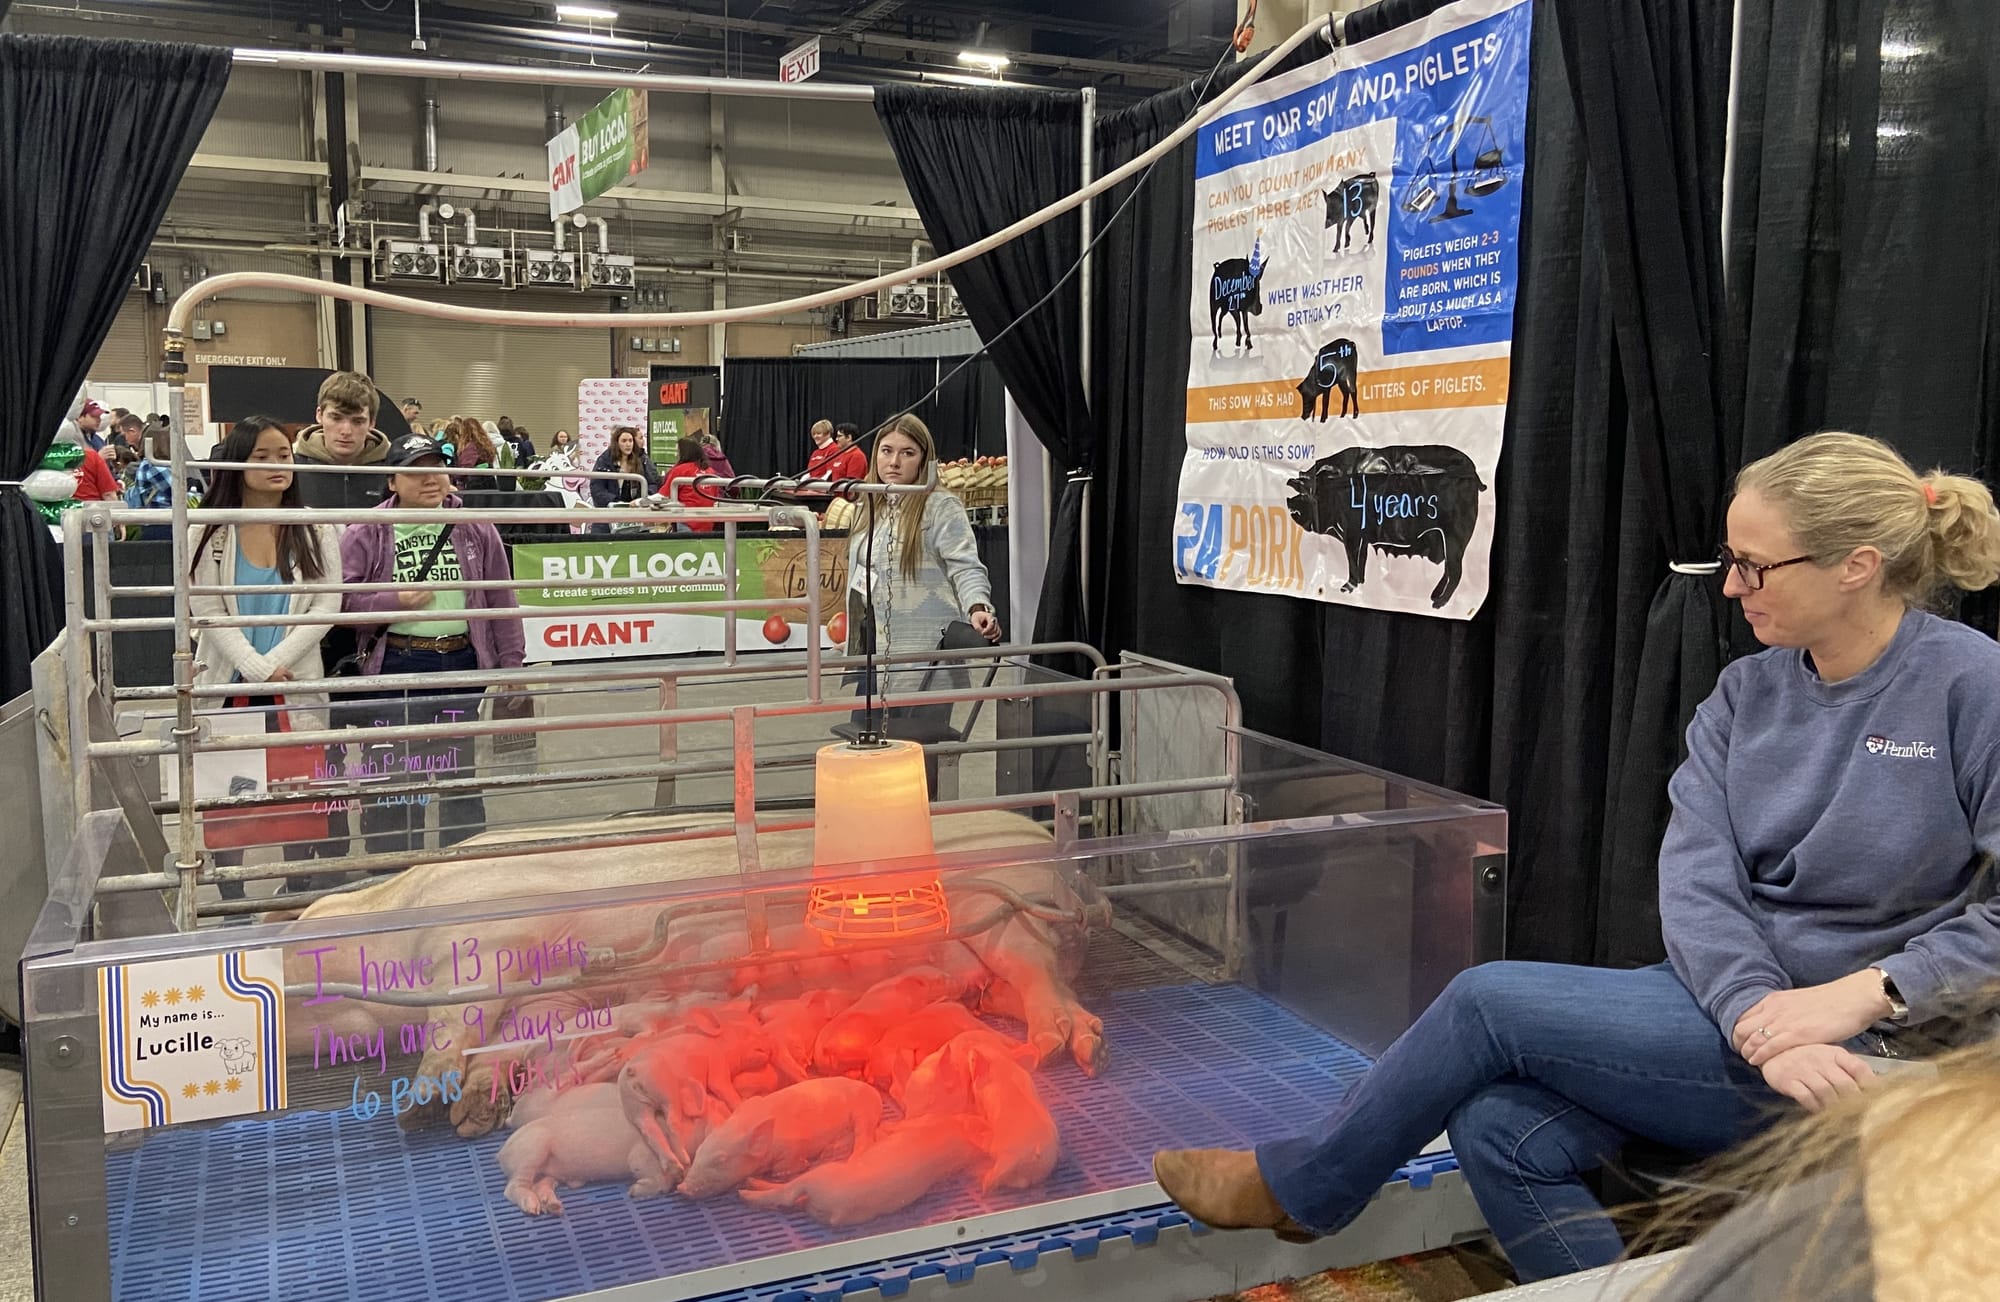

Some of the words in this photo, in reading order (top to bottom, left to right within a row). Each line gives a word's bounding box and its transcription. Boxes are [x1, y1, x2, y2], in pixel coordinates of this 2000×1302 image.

[787, 49, 818, 82] EXIT
[1215, 121, 1255, 156] MEET
[1263, 106, 1301, 140] OUR
[1347, 72, 1396, 110] AND
[1405, 32, 1498, 94] PIGLETS
[582, 132, 599, 165] BUY
[1208, 193, 1230, 209] CAN
[1232, 184, 1252, 202] YOU
[1259, 170, 1299, 194] COUNT
[1302, 164, 1324, 185] HOW
[1324, 147, 1366, 174] MANY
[1208, 211, 1248, 235] PIGLETS
[1251, 200, 1291, 222] THERE
[1295, 189, 1319, 212] ARE?
[1342, 181, 1364, 219] 13
[1403, 242, 1441, 262] PIGLETS
[1444, 235, 1479, 254] WEIGH
[1481, 230, 1500, 246] 2-3
[1400, 262, 1439, 281] POUNDS
[1441, 256, 1472, 273] WHEN
[1474, 250, 1501, 267] THEY
[1214, 272, 1257, 301] December
[1302, 281, 1322, 299] WAS
[1323, 275, 1364, 294] THEIR
[1399, 285, 1420, 300] ARE
[1453, 273, 1488, 291] WHICH
[1490, 271, 1501, 285] IS
[1397, 303, 1427, 318] ABOUT
[1429, 301, 1443, 314] AS
[1445, 294, 1476, 312] MUCH
[1477, 292, 1492, 306] AS
[1494, 291, 1502, 304] A
[1426, 316, 1467, 333] LAPTOP.
[195, 354, 244, 365] EMERGENCY
[246, 356, 264, 365] EXIT
[265, 357, 287, 366] ONLY
[660, 382, 688, 405] GIANT
[1209, 396, 1227, 411] THIS
[1229, 394, 1251, 409] SOW
[1255, 392, 1273, 408] HAS
[1276, 391, 1294, 407] HAD
[1362, 381, 1406, 401] LITTERS
[1411, 378, 1430, 396] OF
[1434, 374, 1487, 395] PIGLETS.
[653, 421, 662, 433] BUY
[662, 420, 678, 433] LOCAL
[1203, 446, 1226, 461] HOW
[1229, 446, 1249, 460] OLD
[1251, 446, 1262, 460] IS
[1263, 446, 1285, 460] THIS
[1287, 444, 1315, 460] SOW?
[1350, 474, 1369, 529] 4
[1374, 493, 1439, 526] years
[1219, 504, 1305, 590] PORK
[430, 568, 464, 581] SHO
[542, 554, 620, 581] BUY
[542, 589, 551, 598] &
[553, 587, 588, 598] create
[591, 585, 634, 597] success
[638, 585, 649, 595] in
[652, 584, 678, 596] your
[543, 620, 655, 648] GIANT
[297, 946, 345, 1007] I
[360, 945, 434, 999] have
[451, 937, 483, 987] 13
[496, 937, 588, 995] piglets
[140, 1014, 160, 1028] My
[164, 1012, 198, 1024] name
[202, 1010, 225, 1019] is...
[137, 1031, 213, 1060] Lucille
[309, 1024, 387, 1075] They
[401, 1020, 451, 1054] are
[463, 1004, 486, 1045] 9
[501, 1007, 565, 1051] days
[575, 1000, 613, 1030] old
[352, 1075, 381, 1121] 6
[391, 1070, 463, 1117] BOYS
